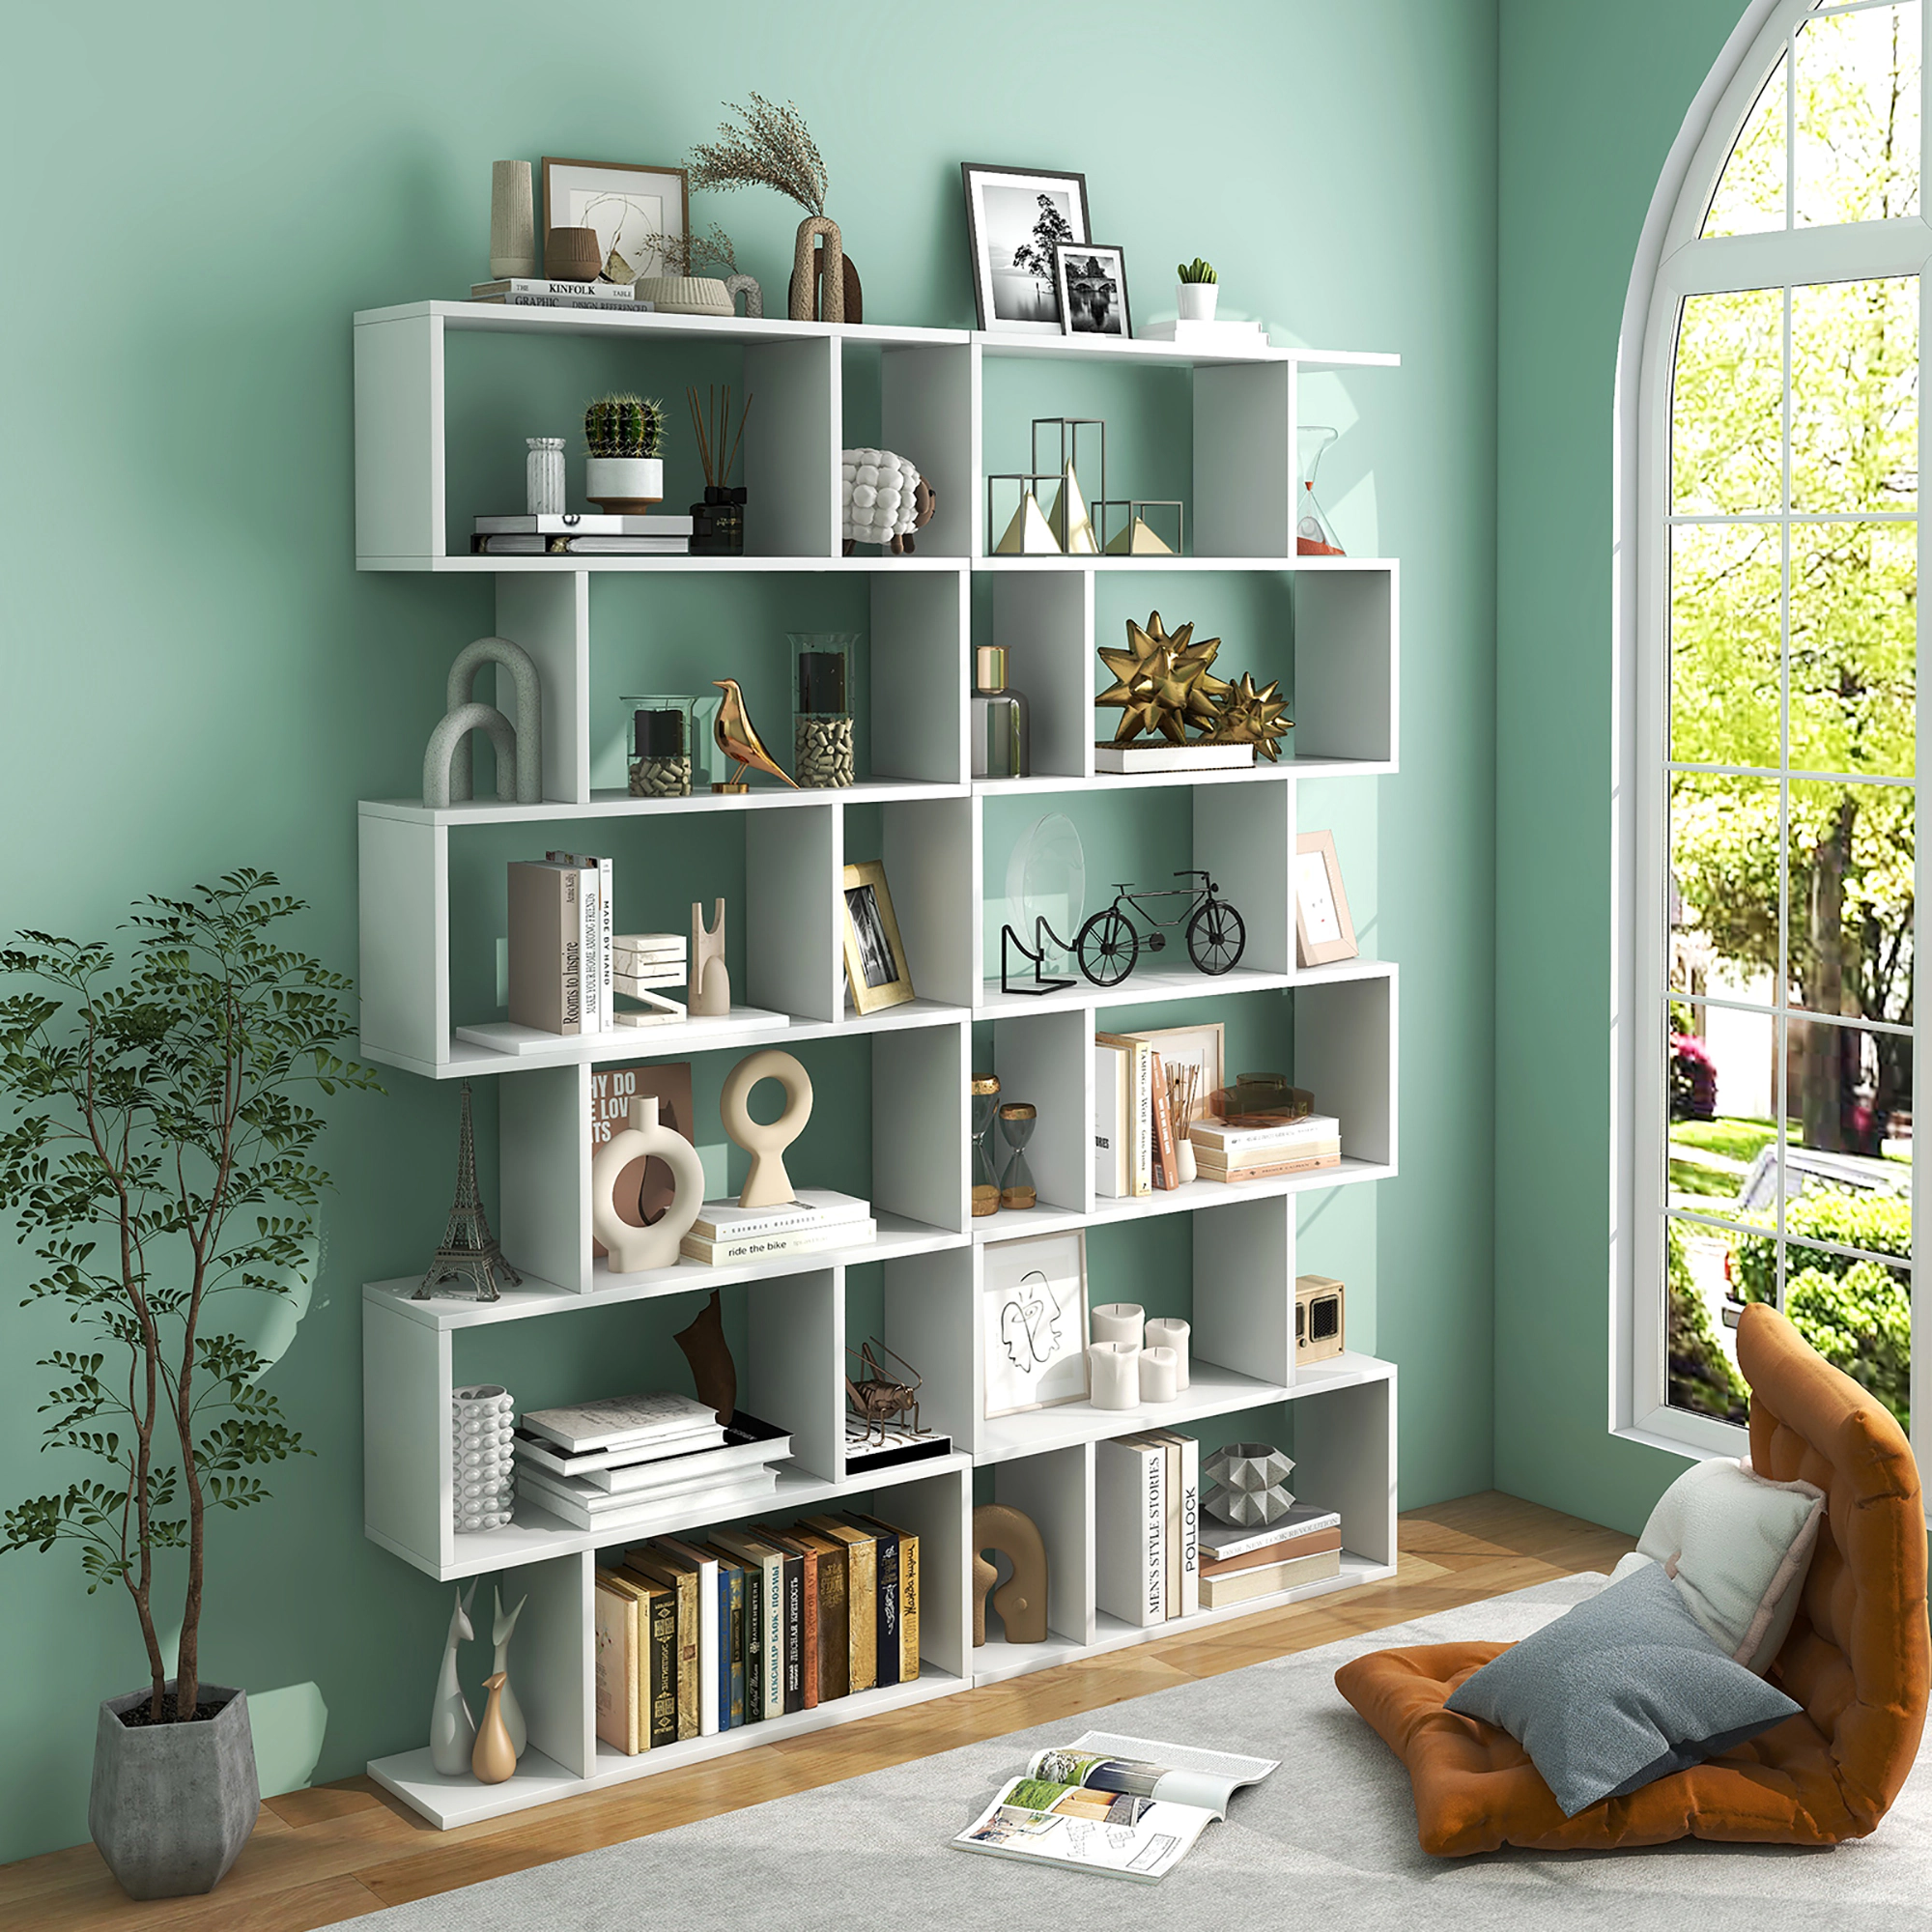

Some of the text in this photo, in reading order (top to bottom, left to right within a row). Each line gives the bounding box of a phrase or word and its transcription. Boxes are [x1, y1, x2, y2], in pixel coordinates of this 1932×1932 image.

[515, 296, 560, 307] GRAPHIC
[516, 283, 633, 298] THE KINFOLK TABLE
[584, 893, 597, 1014] MAKE YOUR HOME AMONG FRIENDS
[603, 936, 611, 951] BY
[561, 941, 580, 976] Inspire
[565, 978, 580, 988] to
[562, 989, 580, 1025] Rooms
[591, 1071, 636, 1099] HY DO
[600, 1096, 629, 1121] LOV
[591, 1121, 611, 1144] TS
[727, 1244, 748, 1257] ride
[749, 1242, 765, 1254] the
[767, 1239, 787, 1252] bike
[1149, 1456, 1160, 1614] MEN'S STYLE STORIES
[1184, 1486, 1197, 1573] POLLOCK
[1288, 1517, 1339, 1539] REVOLUTION
[772, 1565, 781, 1608] ПОЭМЫ
